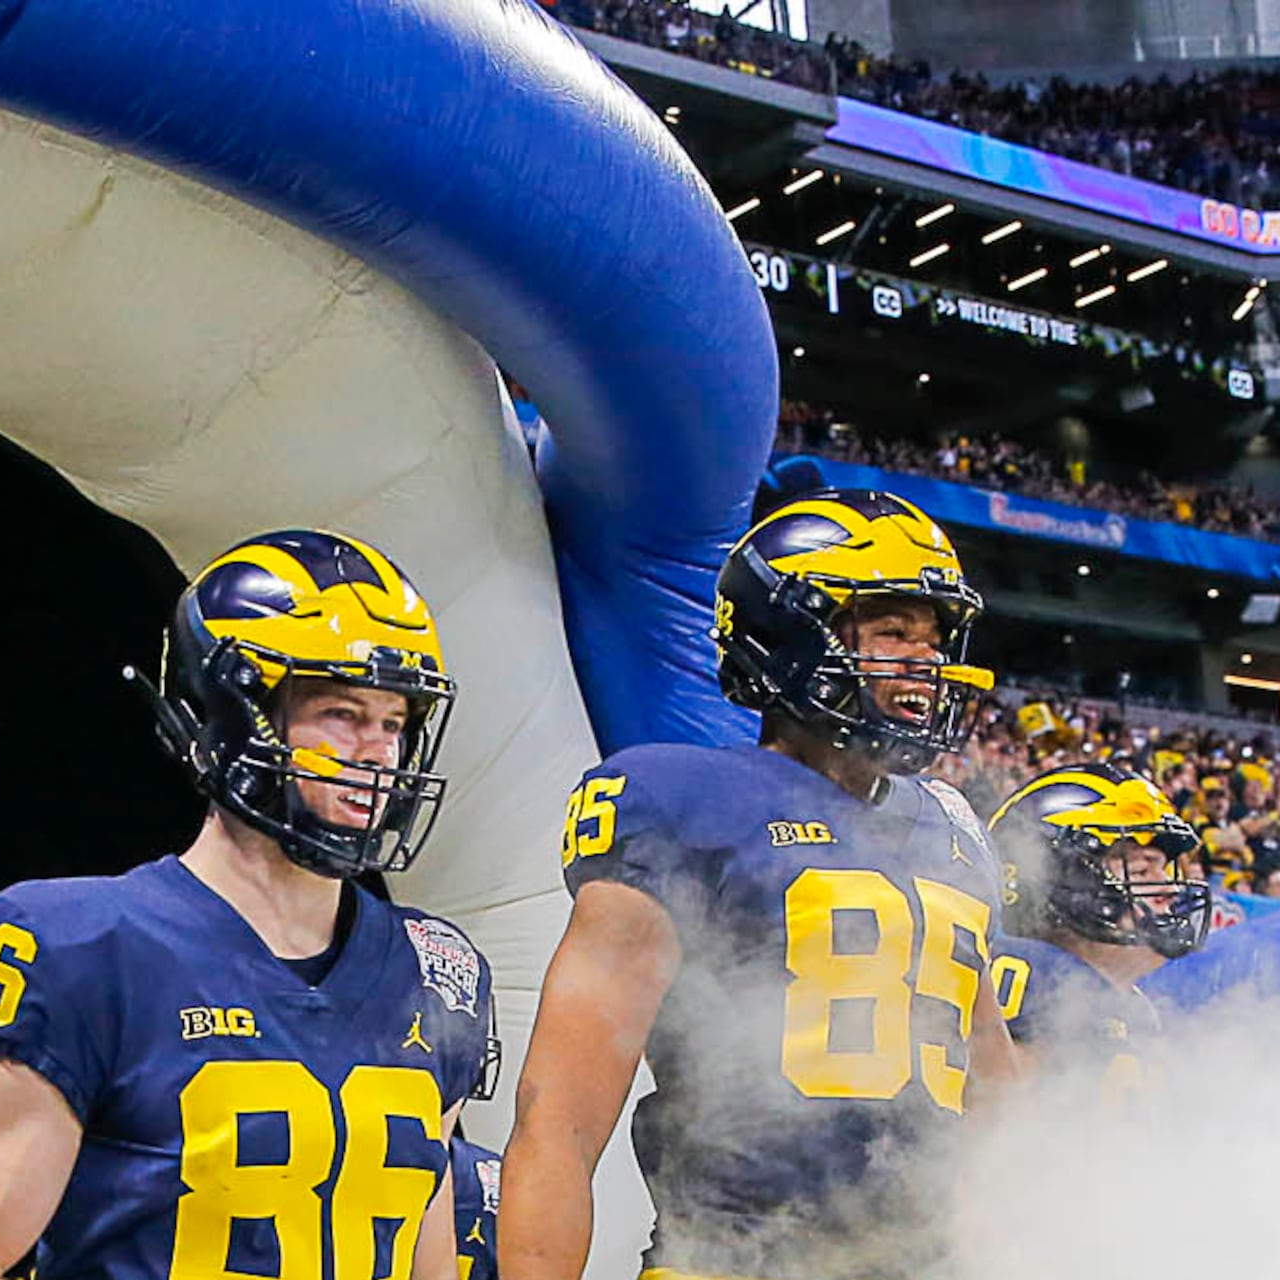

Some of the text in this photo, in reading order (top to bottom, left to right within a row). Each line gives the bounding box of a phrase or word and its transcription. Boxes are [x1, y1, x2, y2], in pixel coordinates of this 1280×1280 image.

[958, 299, 1029, 332] WELCOME
[1029, 314, 1049, 338] TO
[1051, 317, 1078, 346] THE
[562, 776, 626, 868] 85
[781, 867, 991, 1116] 85
